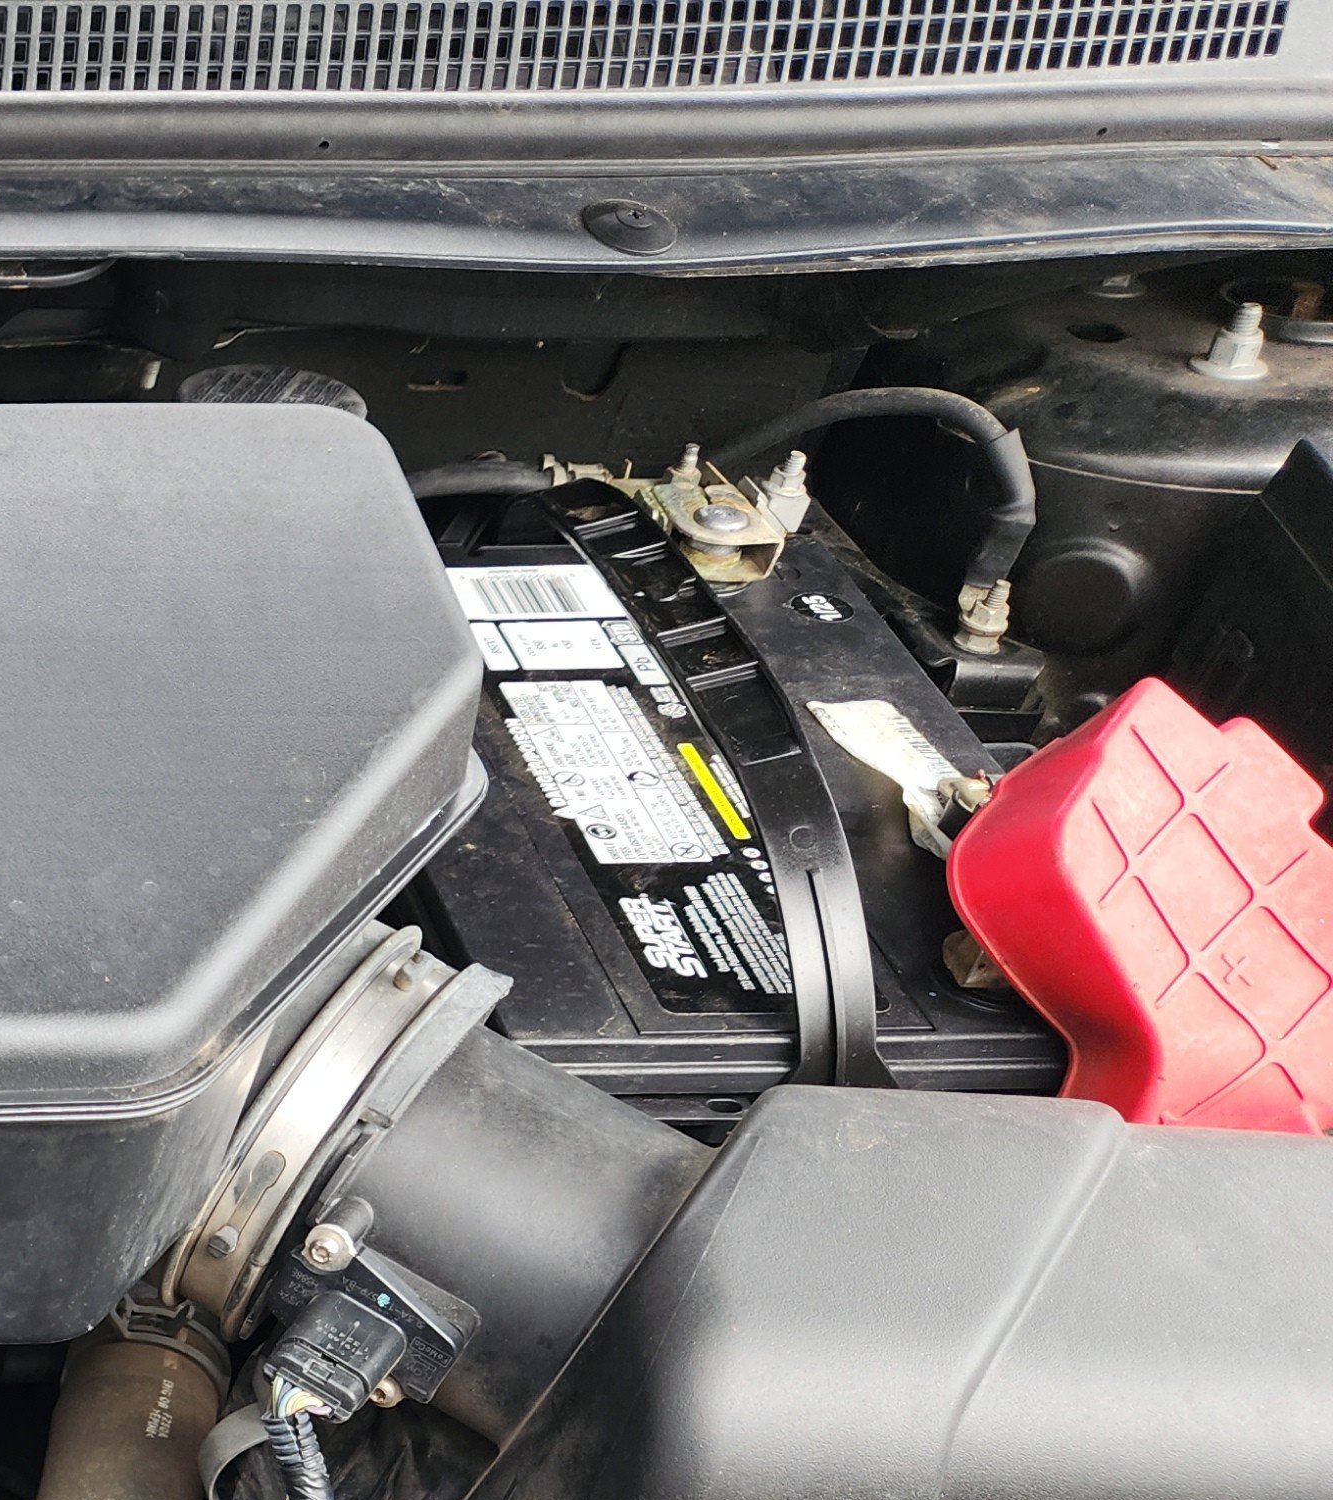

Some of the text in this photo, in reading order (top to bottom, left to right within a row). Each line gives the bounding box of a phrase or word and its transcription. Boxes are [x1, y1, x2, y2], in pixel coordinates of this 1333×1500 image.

[632, 655, 656, 672] Pb
[503, 718, 566, 808] DANGER/POISON
[618, 896, 677, 968] SUPER
[638, 896, 709, 978] START
